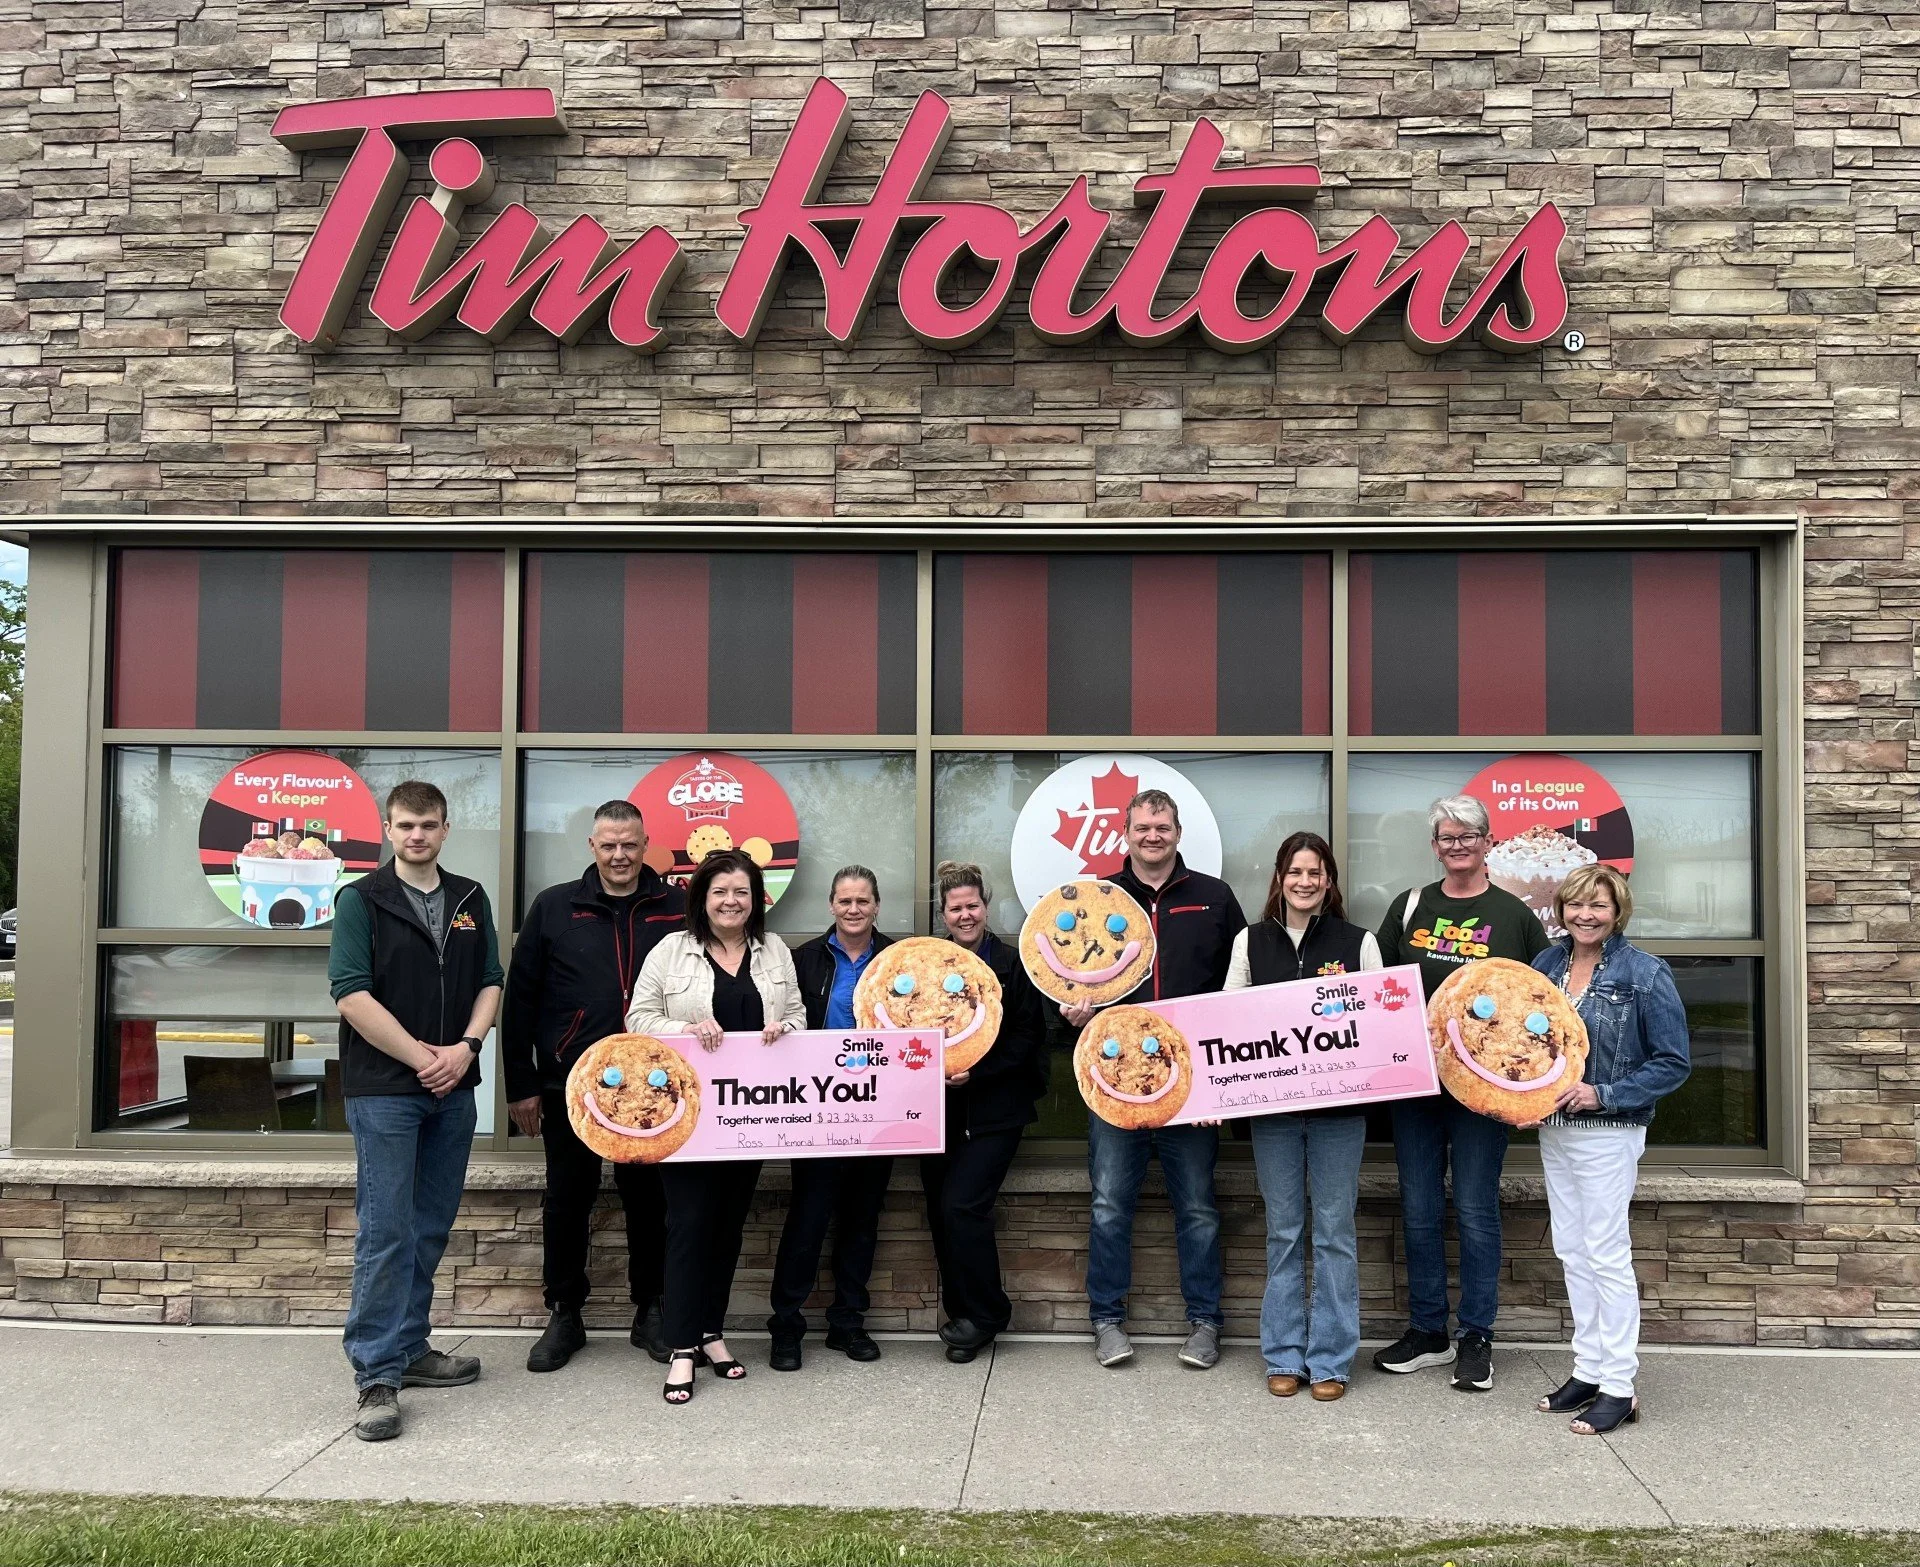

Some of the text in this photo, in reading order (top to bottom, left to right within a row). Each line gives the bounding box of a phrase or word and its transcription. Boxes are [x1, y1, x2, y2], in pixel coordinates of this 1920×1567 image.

[270, 87, 682, 347] Tim
[714, 78, 1569, 349] Hortons
[234, 772, 353, 790] Every Flavour's
[1492, 780, 1585, 796] In a League
[257, 791, 328, 807] a Keeper
[668, 782, 744, 806] GLOBE
[1498, 797, 1579, 811] of its Own
[1067, 807, 1130, 856] Tim
[1433, 917, 1492, 944] Food
[1409, 928, 1490, 957] Source
[1426, 951, 1464, 963] kawartha
[1324, 960, 1345, 971] Food
[1316, 983, 1358, 1000] Smile
[1379, 988, 1407, 1004] Tims
[1311, 998, 1365, 1016] Cookie
[843, 1038, 884, 1052] Smile
[1198, 1020, 1360, 1067] Thank You!
[835, 1053, 889, 1067] Cookie
[903, 1048, 929, 1063] Tims
[1392, 1053, 1409, 1063] for
[1208, 1065, 1298, 1086] Together we raised
[711, 1075, 878, 1106] Thank You!
[1218, 1080, 1372, 1108] Kawartha Lakes Food Source
[716, 1113, 811, 1127] Together we raised
[906, 1110, 922, 1120] for
[737, 1132, 862, 1148] Ross Memorial Hospital
